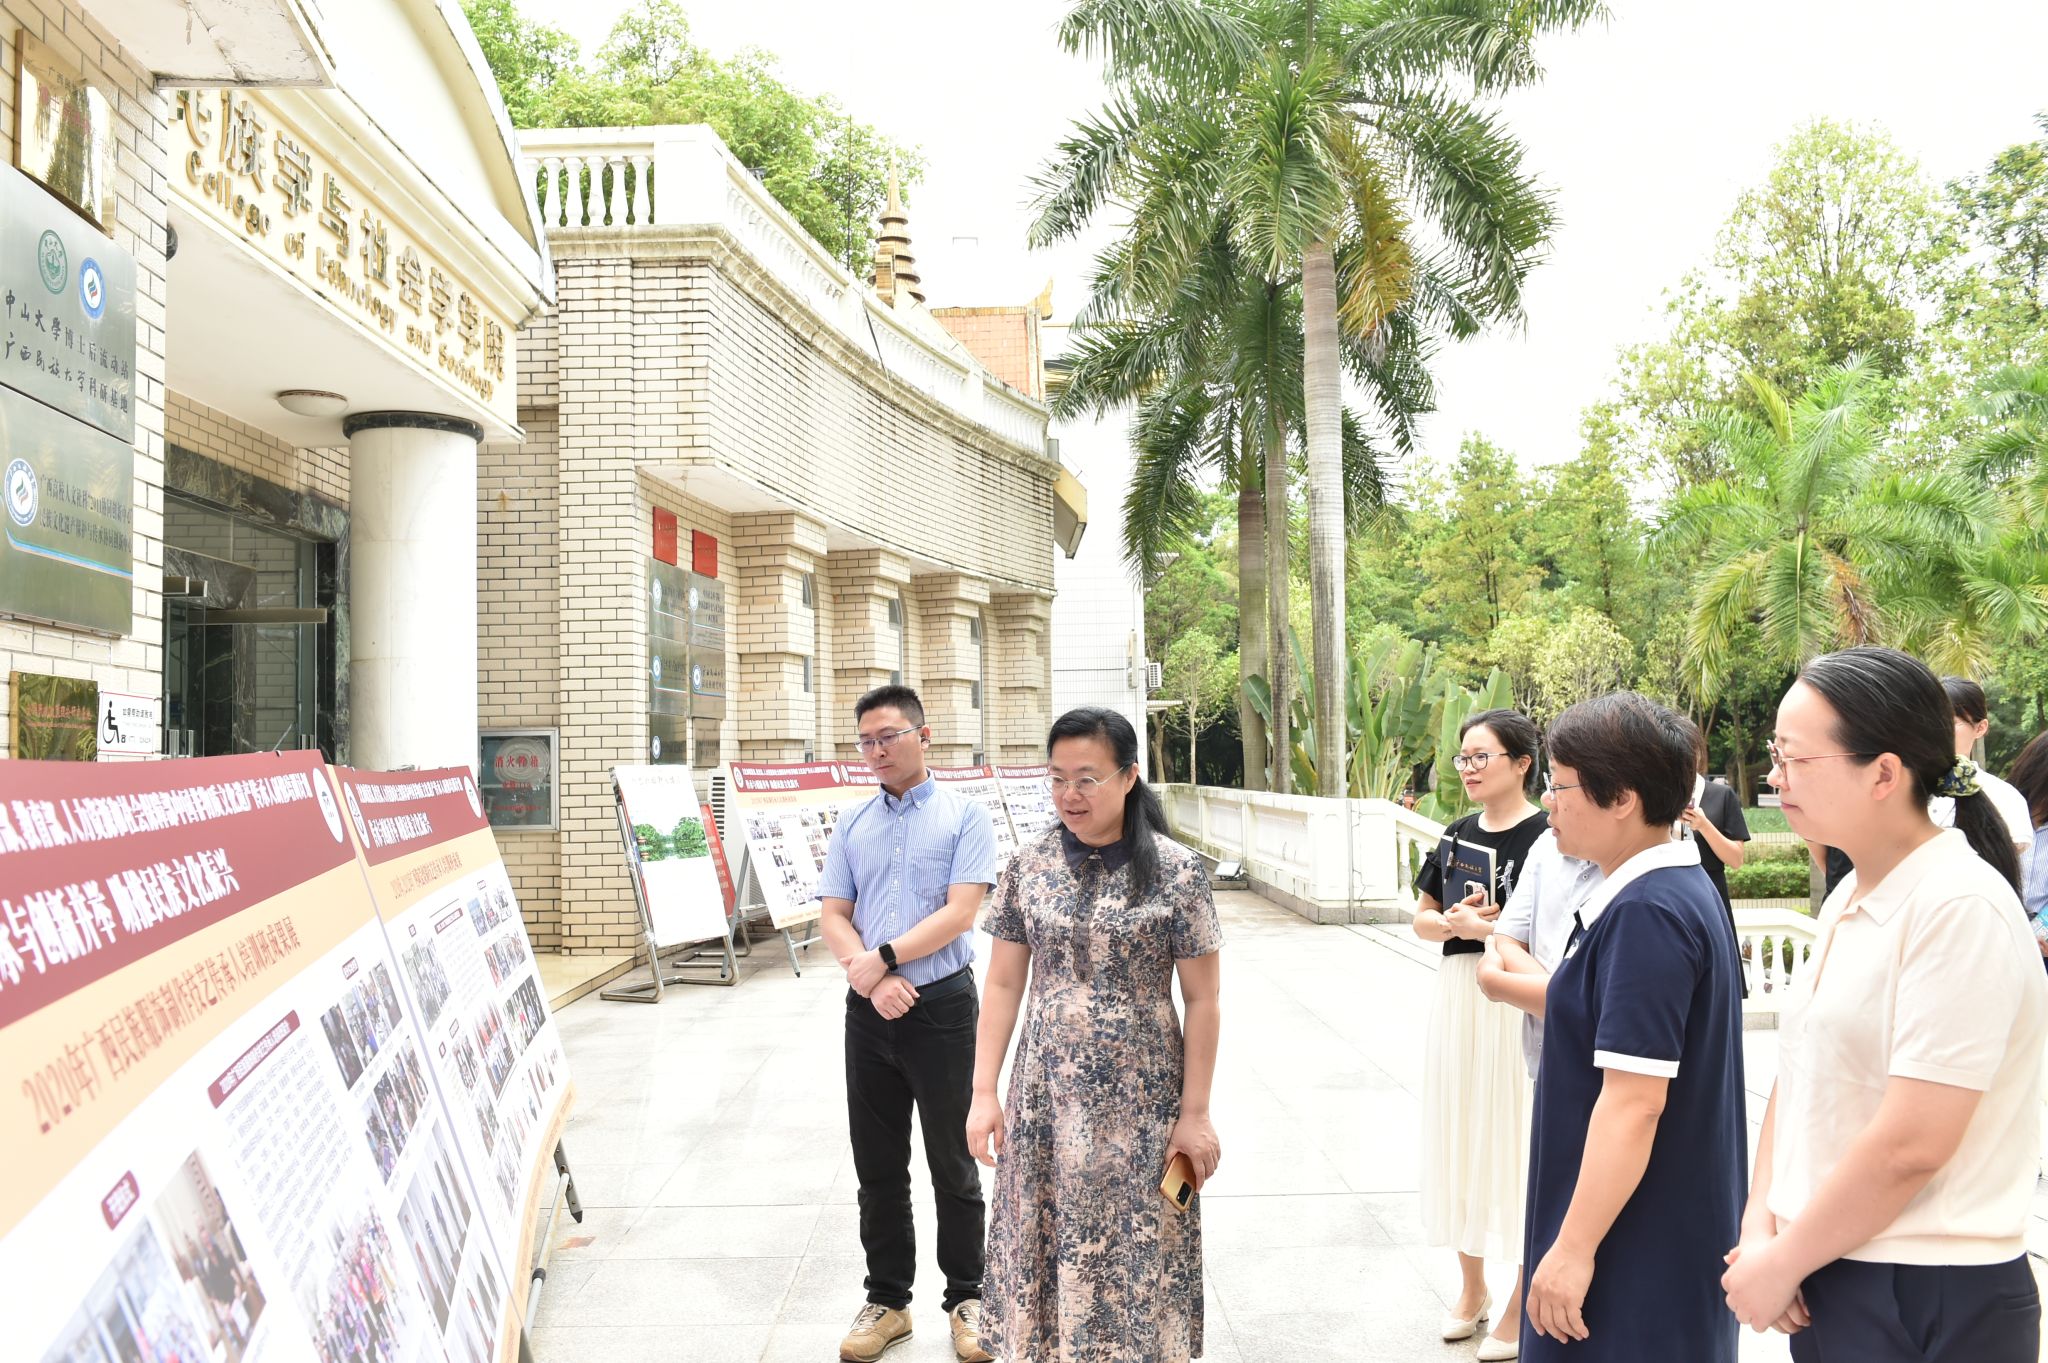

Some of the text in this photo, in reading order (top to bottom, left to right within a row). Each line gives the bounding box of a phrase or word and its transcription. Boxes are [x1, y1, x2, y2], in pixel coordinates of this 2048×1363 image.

[186, 150, 493, 402] College of Ethnology and Sociology
